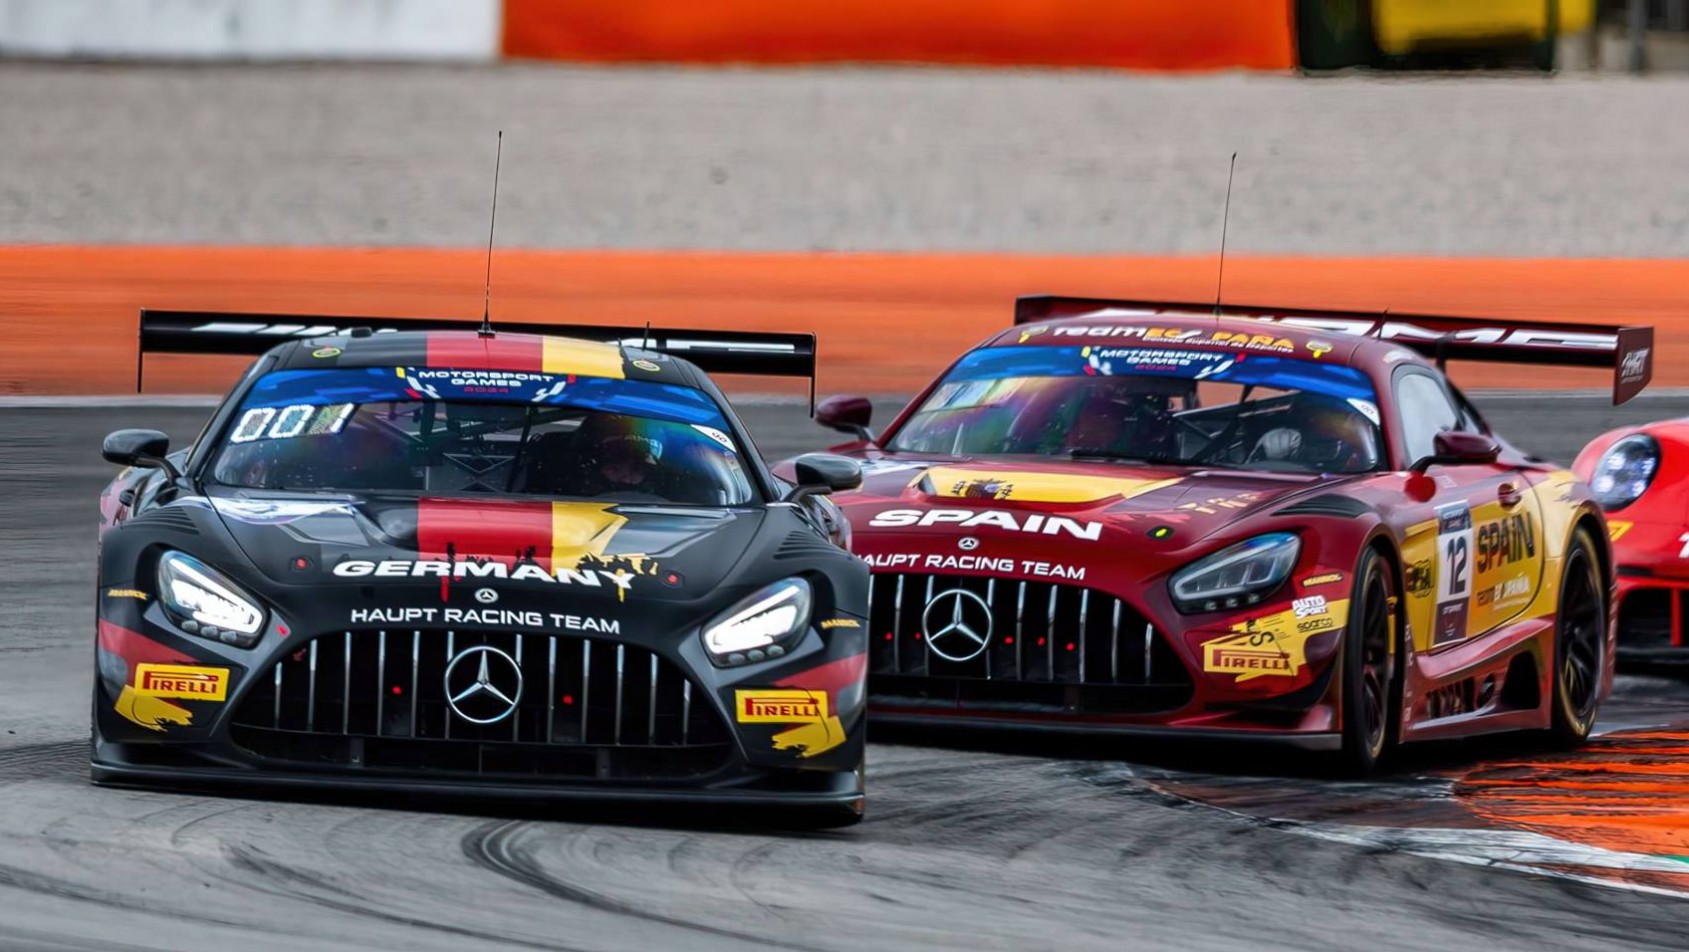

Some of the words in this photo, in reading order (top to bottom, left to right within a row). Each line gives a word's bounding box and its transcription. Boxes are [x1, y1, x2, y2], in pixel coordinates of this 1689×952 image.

[1100, 349, 1224, 361] MOTORSPORT
[1126, 356, 1191, 366] GAMES
[418, 370, 553, 382] MOTORSPORT
[451, 378, 522, 387] GAMES
[869, 508, 1103, 541] SPAIN
[1477, 512, 1535, 574] SPAIN
[333, 560, 636, 590] GERMANY
[925, 555, 1014, 571] RACING
[1021, 560, 1085, 580] TEAM
[1447, 536, 1467, 595] 12
[351, 608, 437, 623] HAUPT
[445, 608, 543, 626] RACING
[550, 613, 620, 634] TEAM
[1212, 649, 1290, 670] PIRELLI
[142, 671, 219, 694] PIRELLI
[745, 697, 819, 717] PIRELLI
